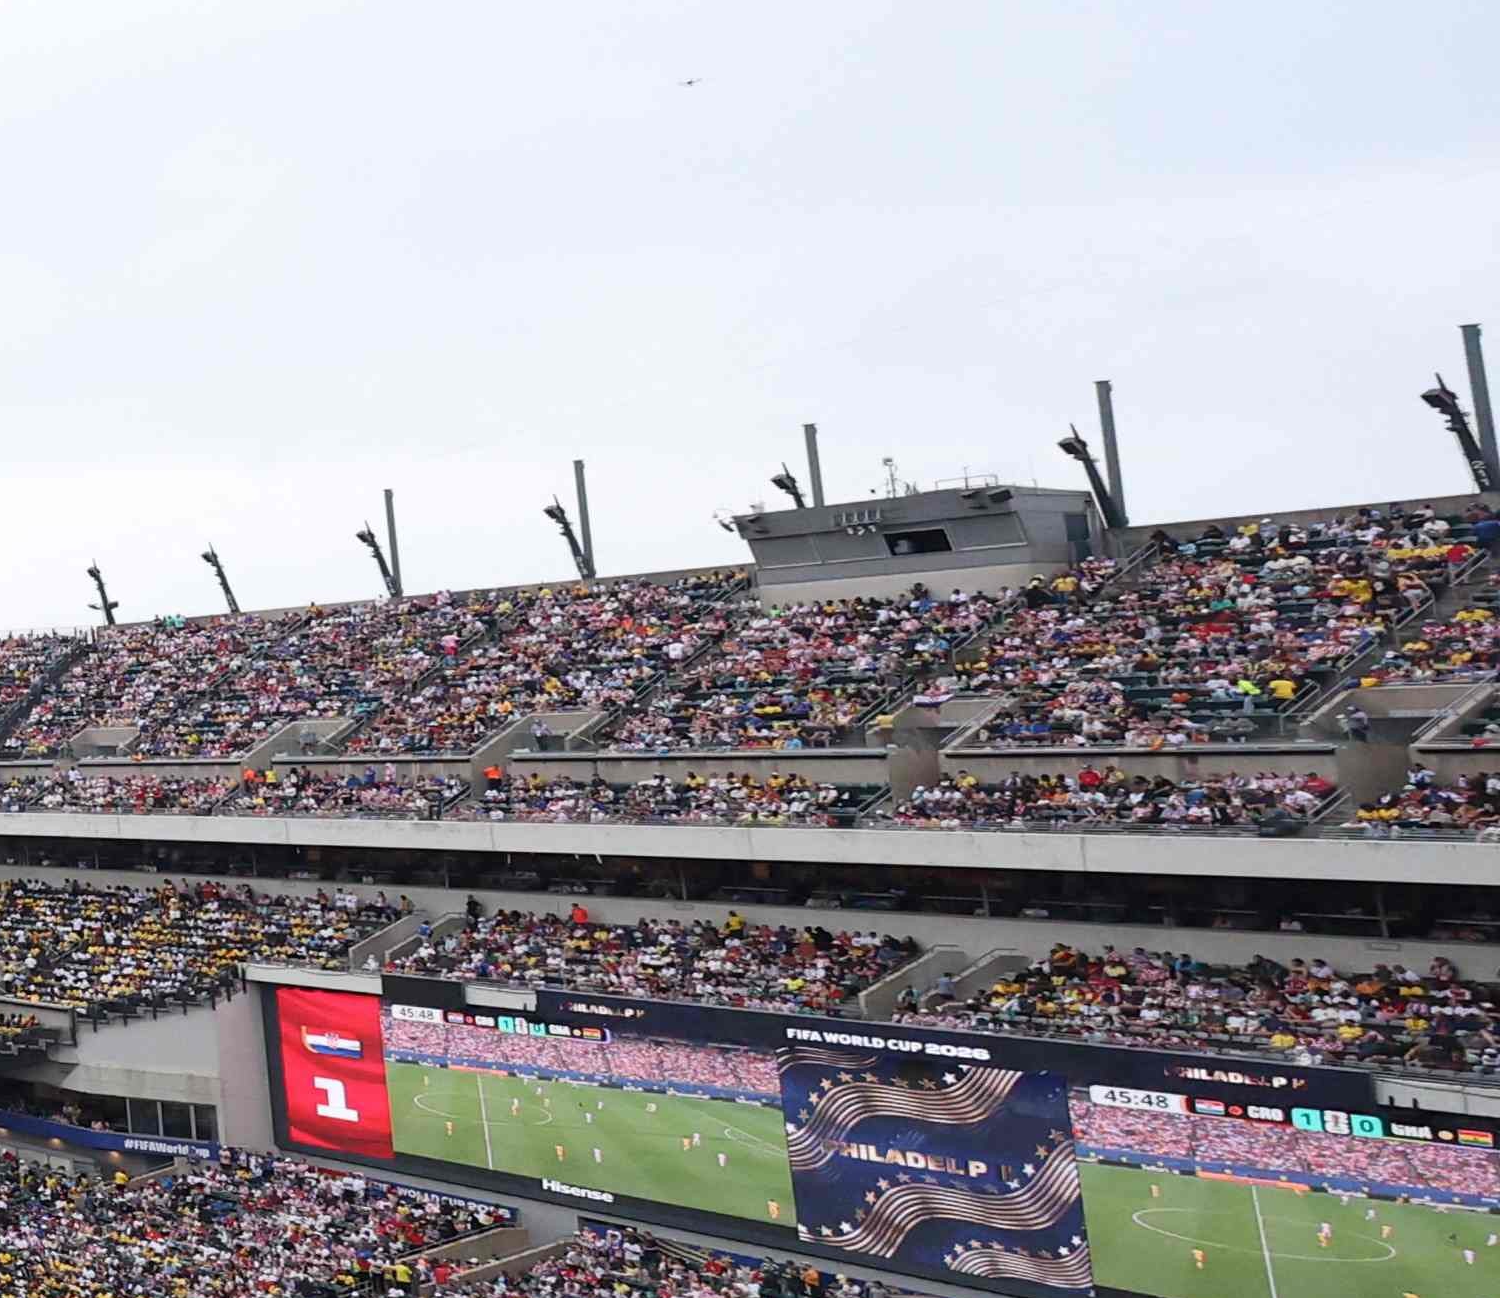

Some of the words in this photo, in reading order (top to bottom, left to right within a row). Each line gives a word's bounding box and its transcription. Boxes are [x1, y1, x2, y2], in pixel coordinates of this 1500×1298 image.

[399, 1007, 434, 1021] 45:48
[786, 1028, 823, 1043] FIFA
[823, 1031, 886, 1050] WORLD
[887, 1039, 923, 1053] CUP
[313, 1076, 359, 1122] 1
[1103, 1090, 1169, 1109] 45:48
[1360, 1120, 1373, 1133] 0
[541, 1178, 615, 1204] Hisense
